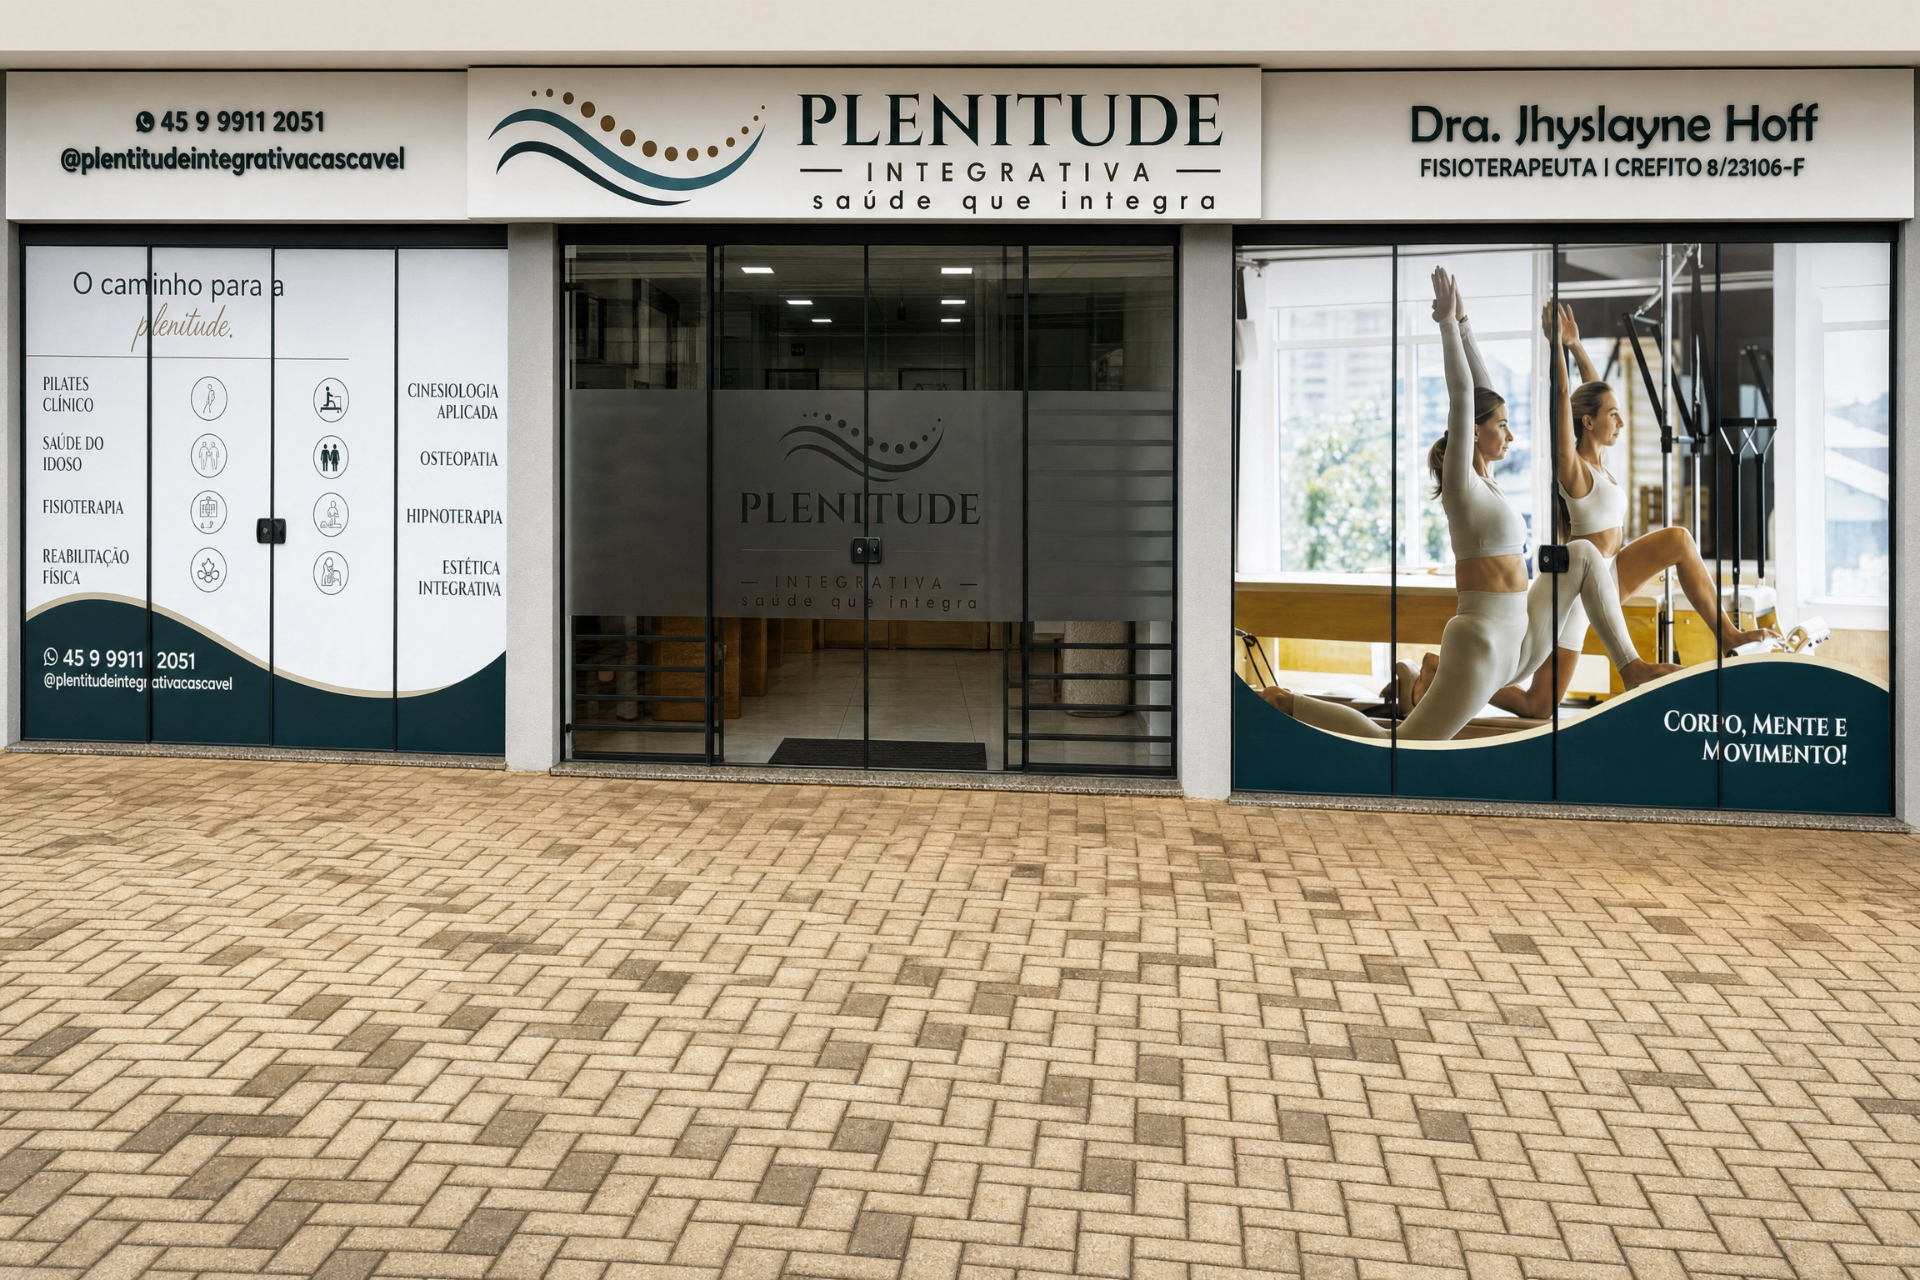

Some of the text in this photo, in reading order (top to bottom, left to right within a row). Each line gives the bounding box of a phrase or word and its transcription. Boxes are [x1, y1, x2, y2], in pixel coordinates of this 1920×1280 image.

[161, 111, 325, 132] 45 9 9911 2051
[798, 93, 1224, 147] PLENITUDE
[1411, 103, 1819, 149] Dra. Jhyslayne Hoff
[60, 146, 405, 176] @plentitudeintegrativacascavel
[1420, 158, 1597, 177] FISIOTERAPEUTA
[1615, 158, 1702, 177] CREFITO
[1707, 157, 1805, 177] 8/23106-F
[867, 162, 1150, 182] INTEGRATIVA
[812, 190, 1216, 214] saúde que integra
[73, 271, 284, 303] O caminho para a
[131, 302, 233, 353] plenitude.
[43, 376, 89, 391] PILATES
[407, 382, 499, 399] CINESIOLOGIA
[43, 394, 94, 413] CLÍNICO
[437, 404, 498, 420] APLICADA
[43, 432, 104, 451] SAÚDE DO
[43, 457, 82, 472] IDOSO
[420, 451, 499, 467] OSTEOPATIA
[43, 500, 124, 515] FISIOTERAPIA
[406, 508, 503, 525] HIPNOTERAPIA
[740, 492, 981, 525] PLENITUDE
[43, 546, 129, 568] REABILITAÇÃO
[442, 556, 500, 576] ESTÉTICA
[43, 567, 80, 585] FÍSICA
[775, 575, 942, 590] INTEGRATIVA
[418, 580, 501, 597] INTEGRATIVA
[741, 593, 977, 612] saúde que integra
[62, 649, 195, 669] 45 9 9911 2051
